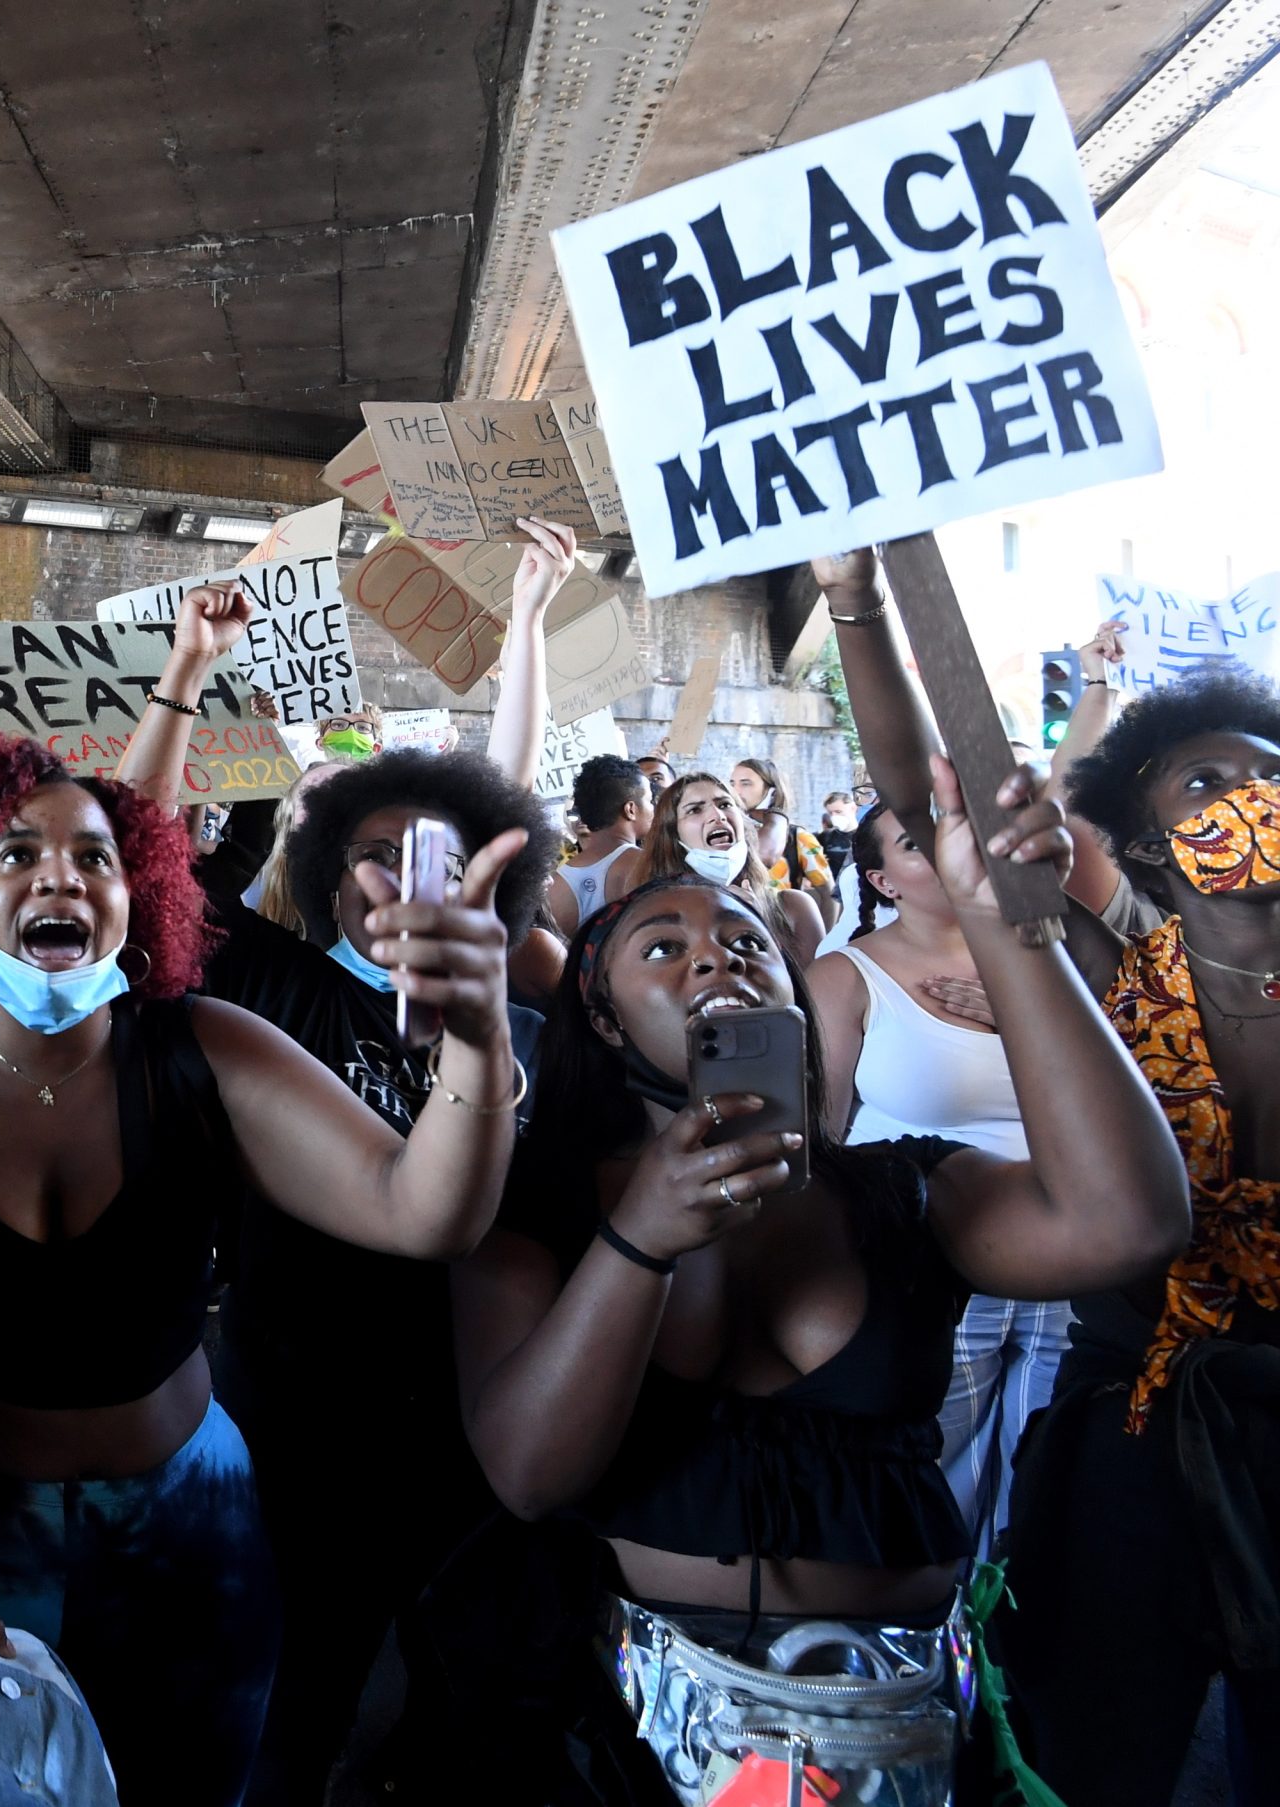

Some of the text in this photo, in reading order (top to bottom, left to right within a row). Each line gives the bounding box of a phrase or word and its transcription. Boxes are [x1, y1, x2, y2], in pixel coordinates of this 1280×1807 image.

[605, 111, 1068, 348] BLACK
[684, 253, 1064, 444] LIVES
[384, 417, 448, 445] THE
[464, 417, 516, 445] UK
[534, 411, 562, 438] IS
[655, 351, 1124, 561] MATTER
[357, 546, 503, 684] COPS
[1102, 578, 1260, 620] WHITE
[270, 651, 353, 690] LIVES
[197, 725, 283, 755] 2014
[392, 729, 440, 743] VIOLENCE
[394, 716, 431, 726] SILENCE
